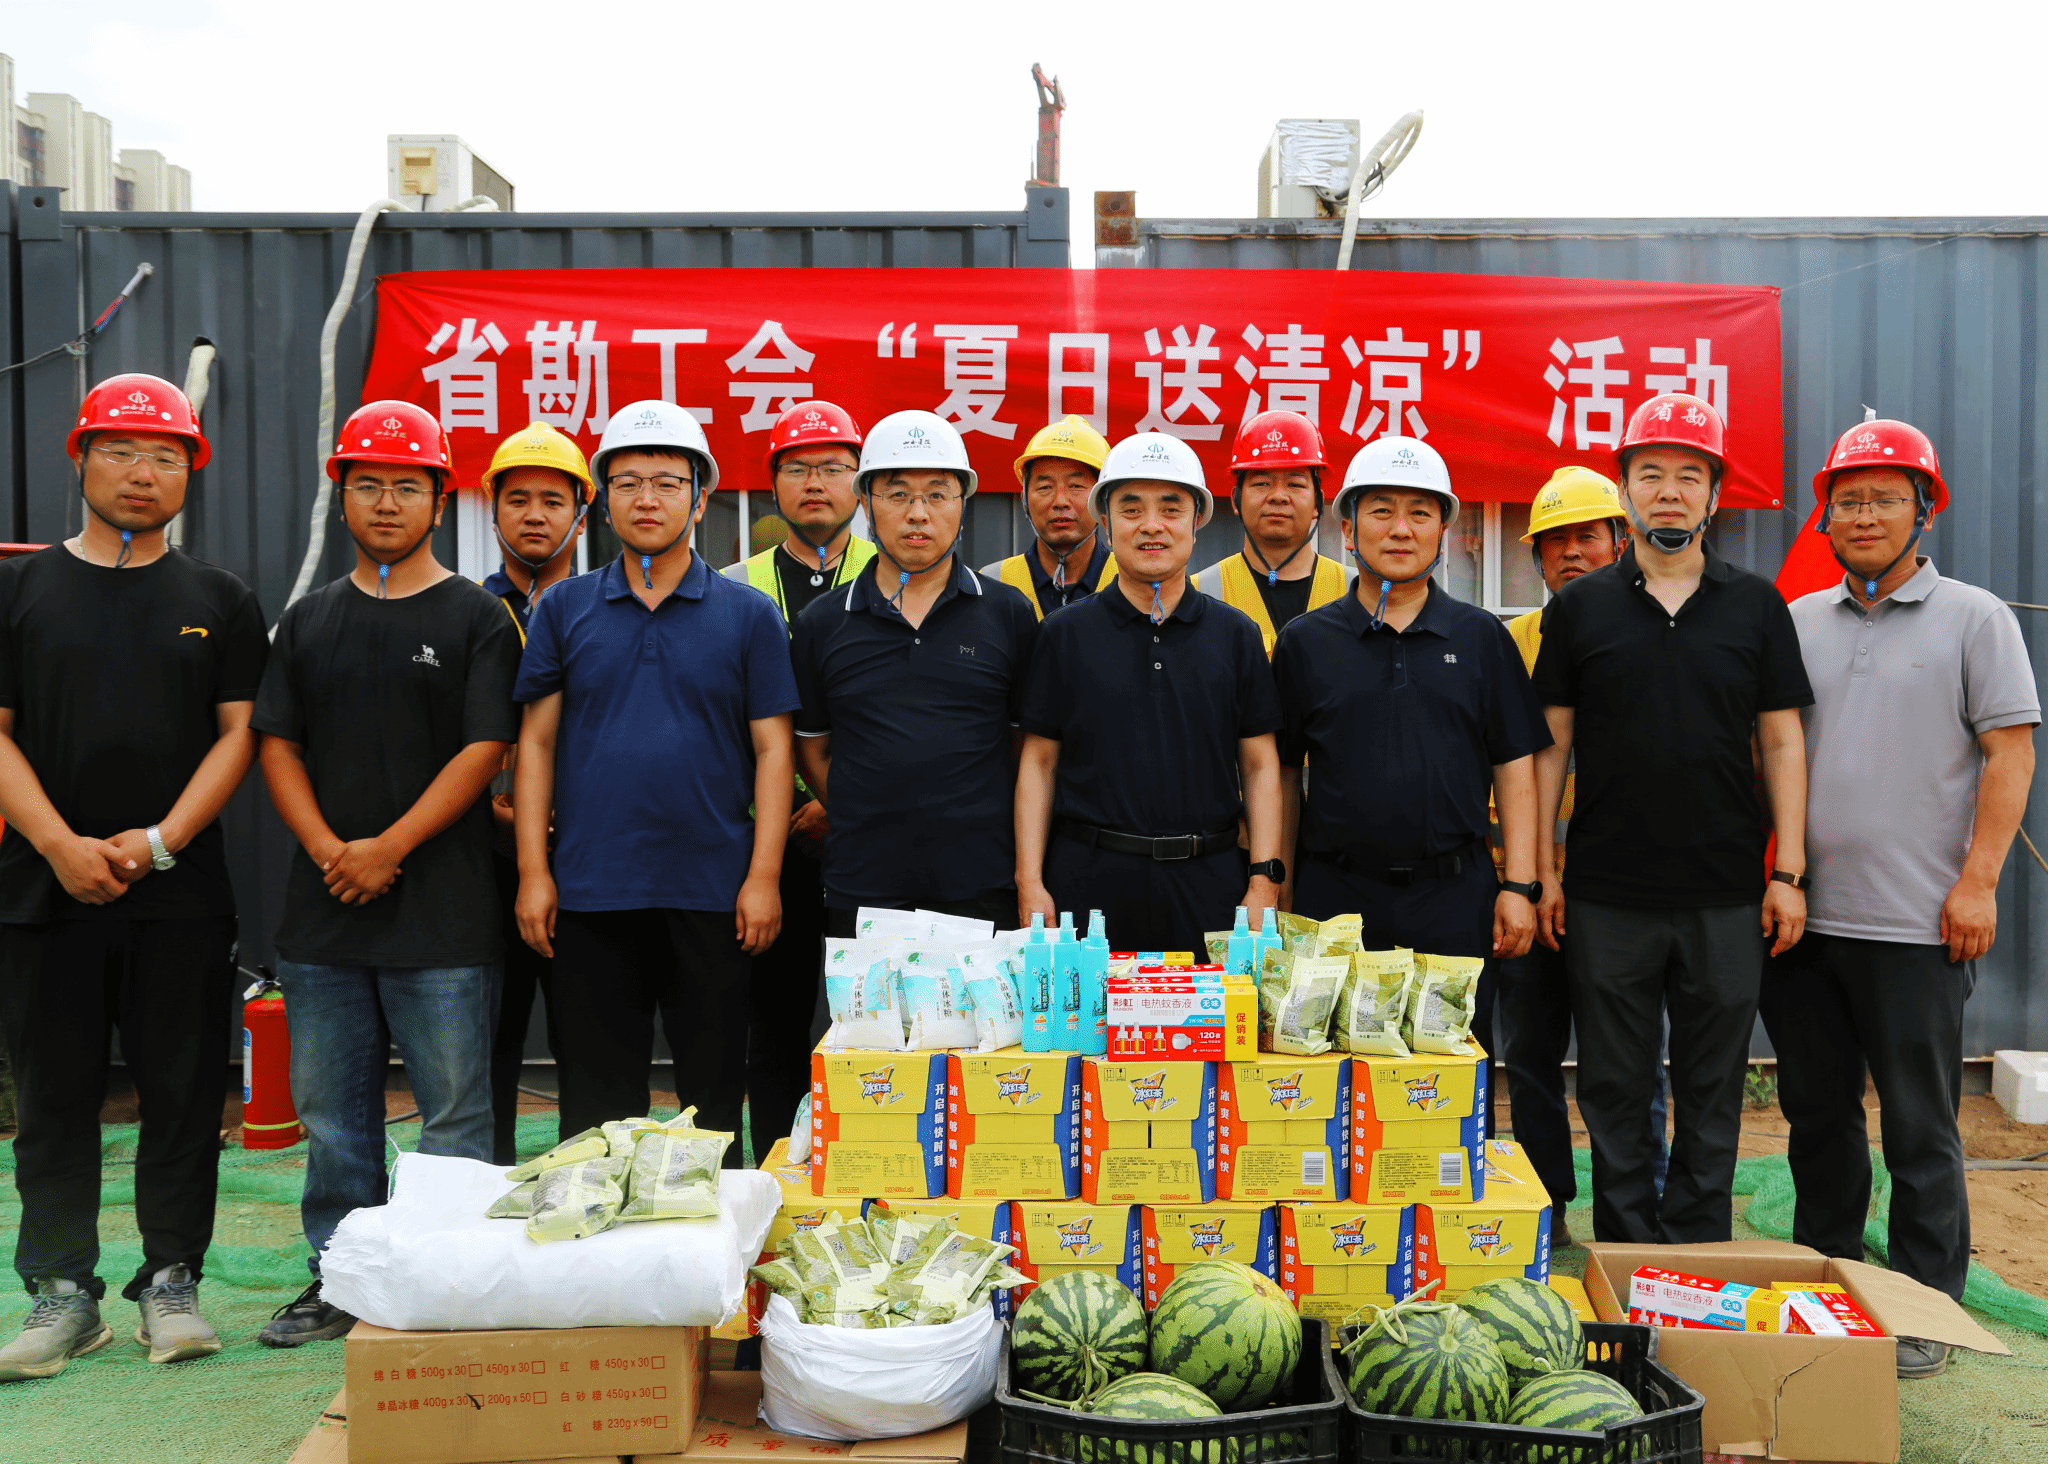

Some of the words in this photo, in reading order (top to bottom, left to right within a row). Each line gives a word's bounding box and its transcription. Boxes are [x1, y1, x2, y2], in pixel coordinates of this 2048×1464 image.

[421, 317, 816, 435] 省勘工会
[1649, 402, 1707, 427] 省勘
[412, 654, 441, 667] CAMEL
[1113, 998, 1133, 1007] 彩虹
[1141, 998, 1192, 1009] 电热蚊香液
[1236, 1013, 1247, 1045] 促销装
[934, 1083, 945, 1167] 开启痛快时刻
[1070, 1084, 1081, 1168] 开启痛快时刻
[1207, 1087, 1216, 1170] 开启痛快时刻
[1341, 1086, 1350, 1169] 开启痛快时刻
[1477, 1087, 1485, 1171] 开启痛快时刻
[1636, 1282, 1655, 1293] 彩虹
[1664, 1288, 1712, 1306] 电热蚊香液
[421, 1367, 445, 1379] 500g
[454, 1365, 467, 1376] 30
[486, 1363, 509, 1375] 450g
[518, 1362, 530, 1373] 30
[605, 1358, 629, 1370] 450g
[637, 1357, 649, 1368] 30
[423, 1397, 447, 1409] 400g
[456, 1395, 469, 1406] 30
[487, 1394, 511, 1405] 200g
[520, 1392, 531, 1403] 50
[606, 1388, 630, 1400] 450g
[639, 1387, 651, 1398] 30
[607, 1418, 631, 1430] 230g
[641, 1417, 652, 1428] 50
